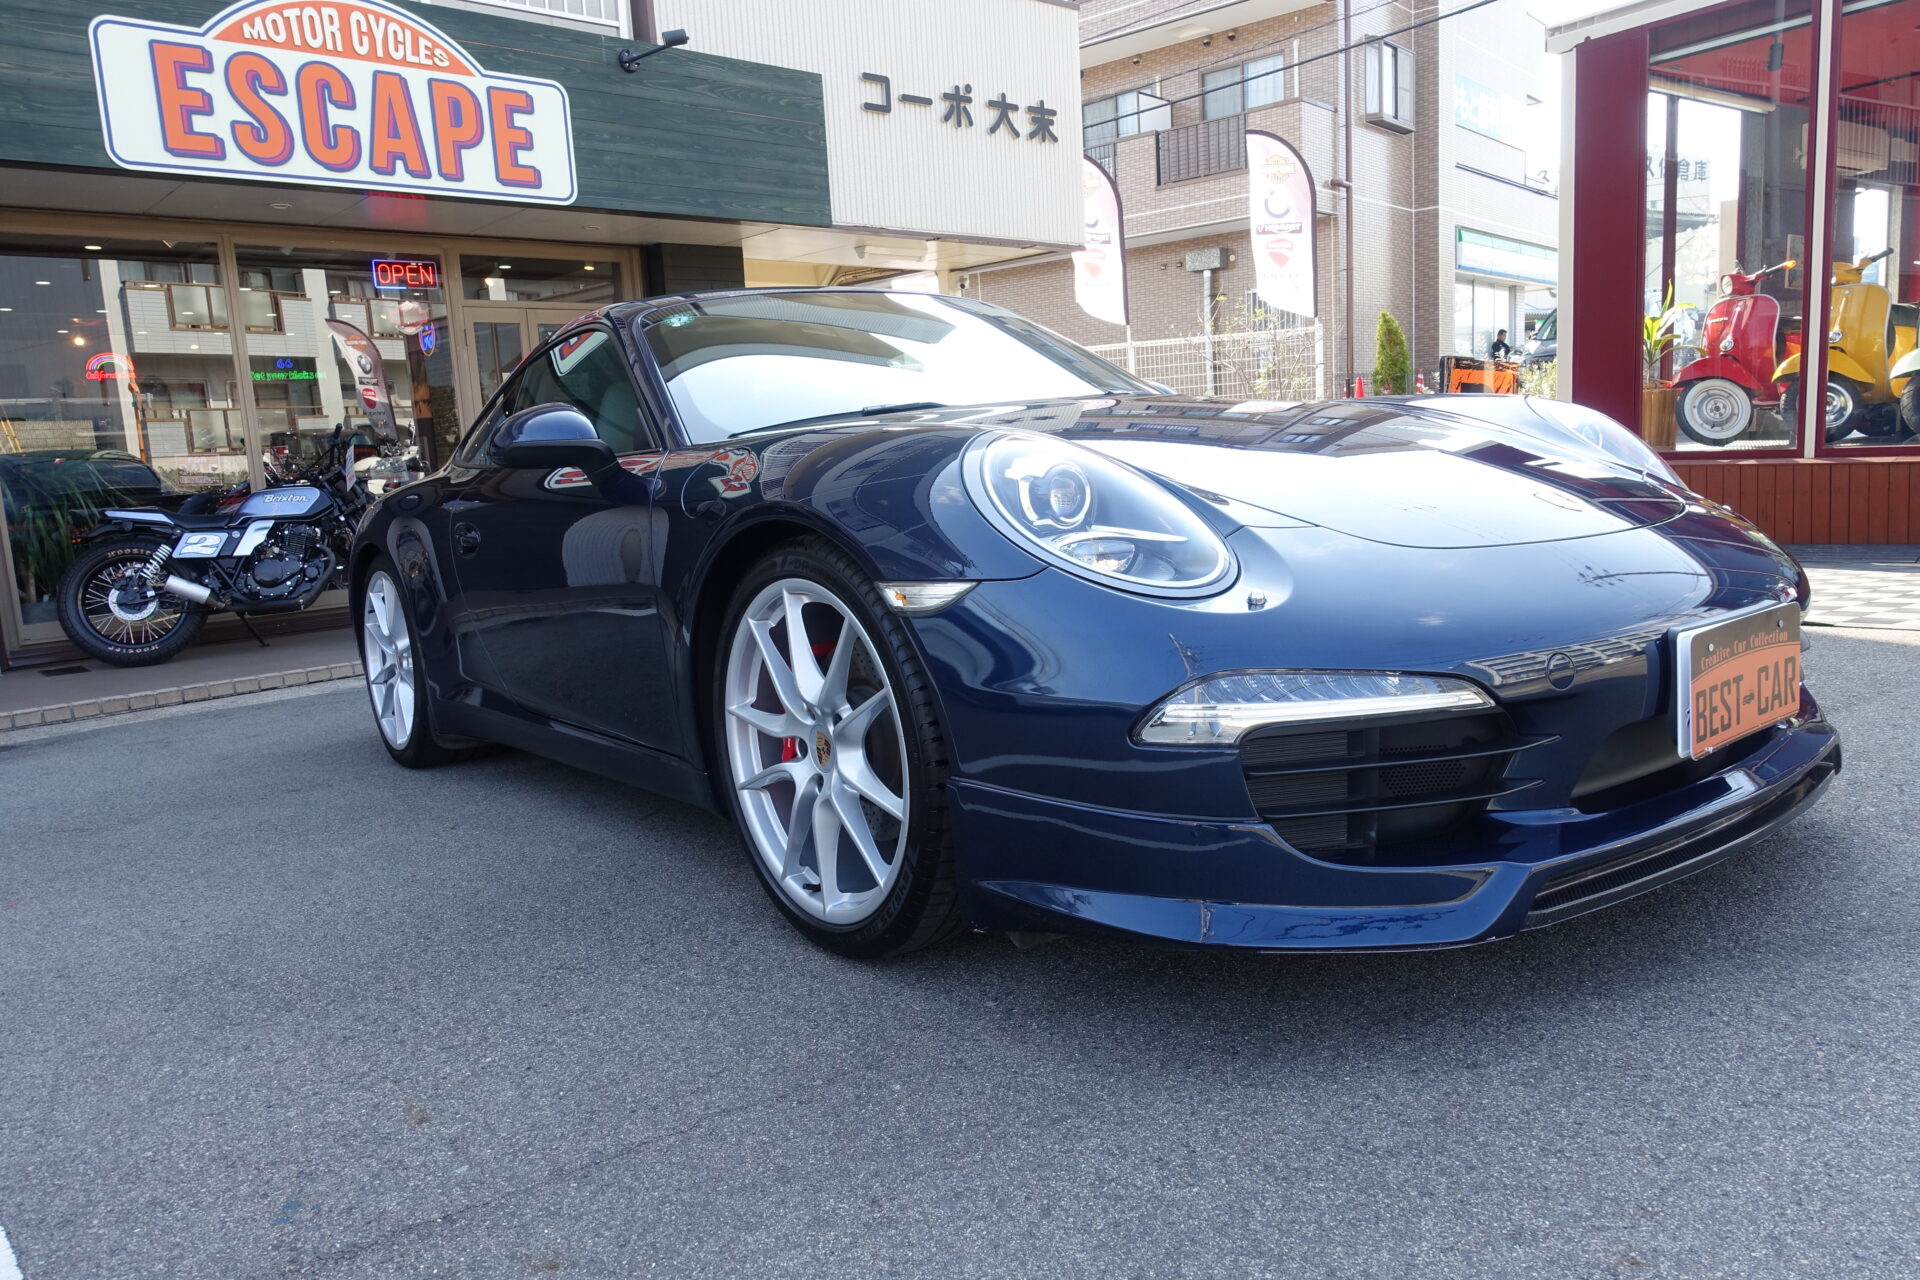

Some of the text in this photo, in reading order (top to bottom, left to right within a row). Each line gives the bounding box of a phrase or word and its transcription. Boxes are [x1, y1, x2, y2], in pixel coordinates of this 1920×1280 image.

[242, 6, 450, 68] MOTOR CYCLES
[149, 39, 543, 190] ESCAPE
[377, 263, 434, 285] OPEN
[264, 494, 308, 503] Brixton
[180, 534, 222, 556] 2
[1701, 629, 1789, 671] Creative Car Collection
